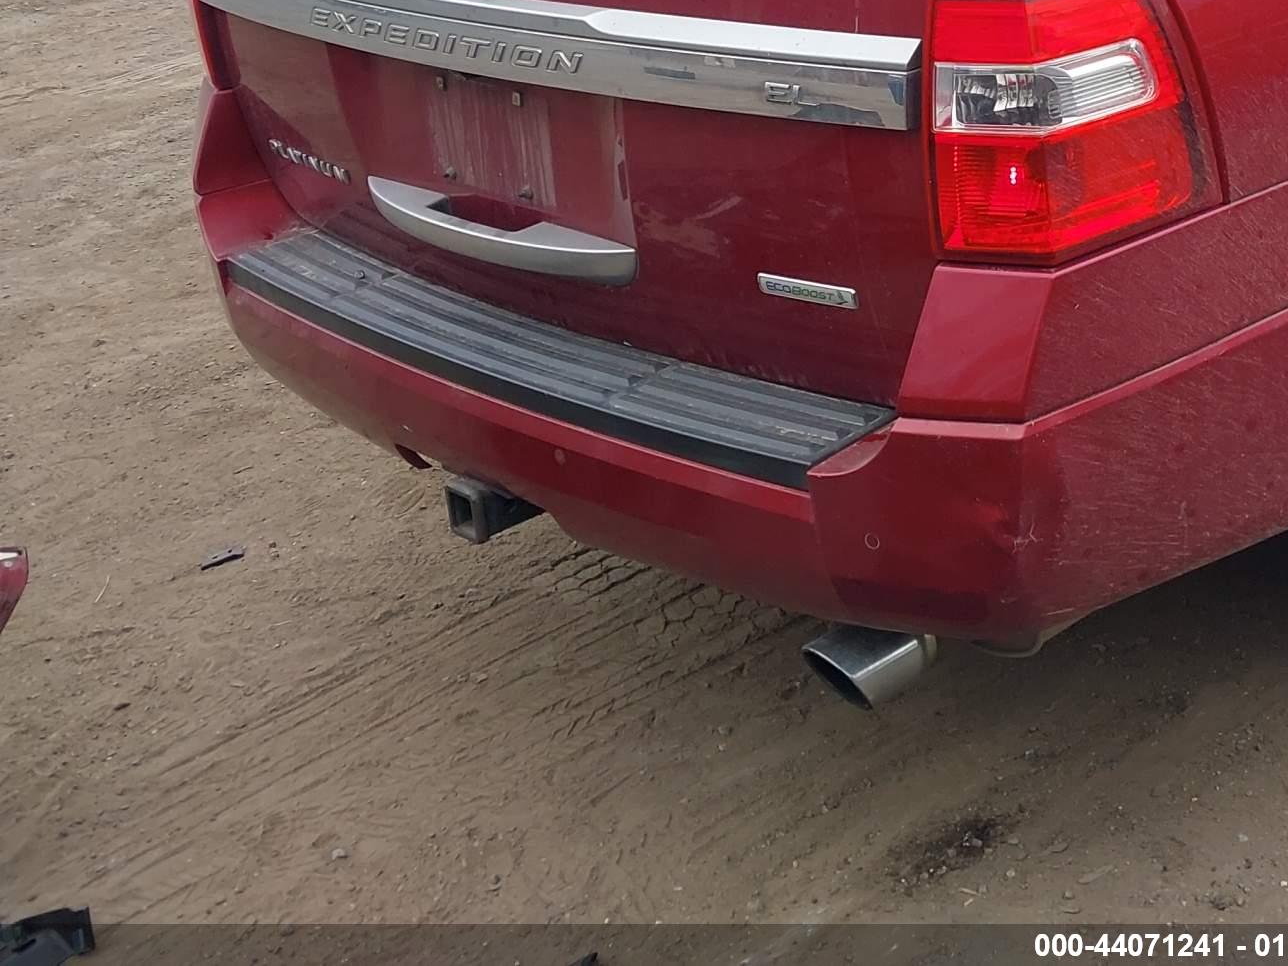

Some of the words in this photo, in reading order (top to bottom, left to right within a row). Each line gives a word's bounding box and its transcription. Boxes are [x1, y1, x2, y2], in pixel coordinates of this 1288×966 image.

[309, 5, 584, 76] EXPEDITION
[764, 80, 819, 107] EL
[765, 280, 836, 302] ECOBOOST
